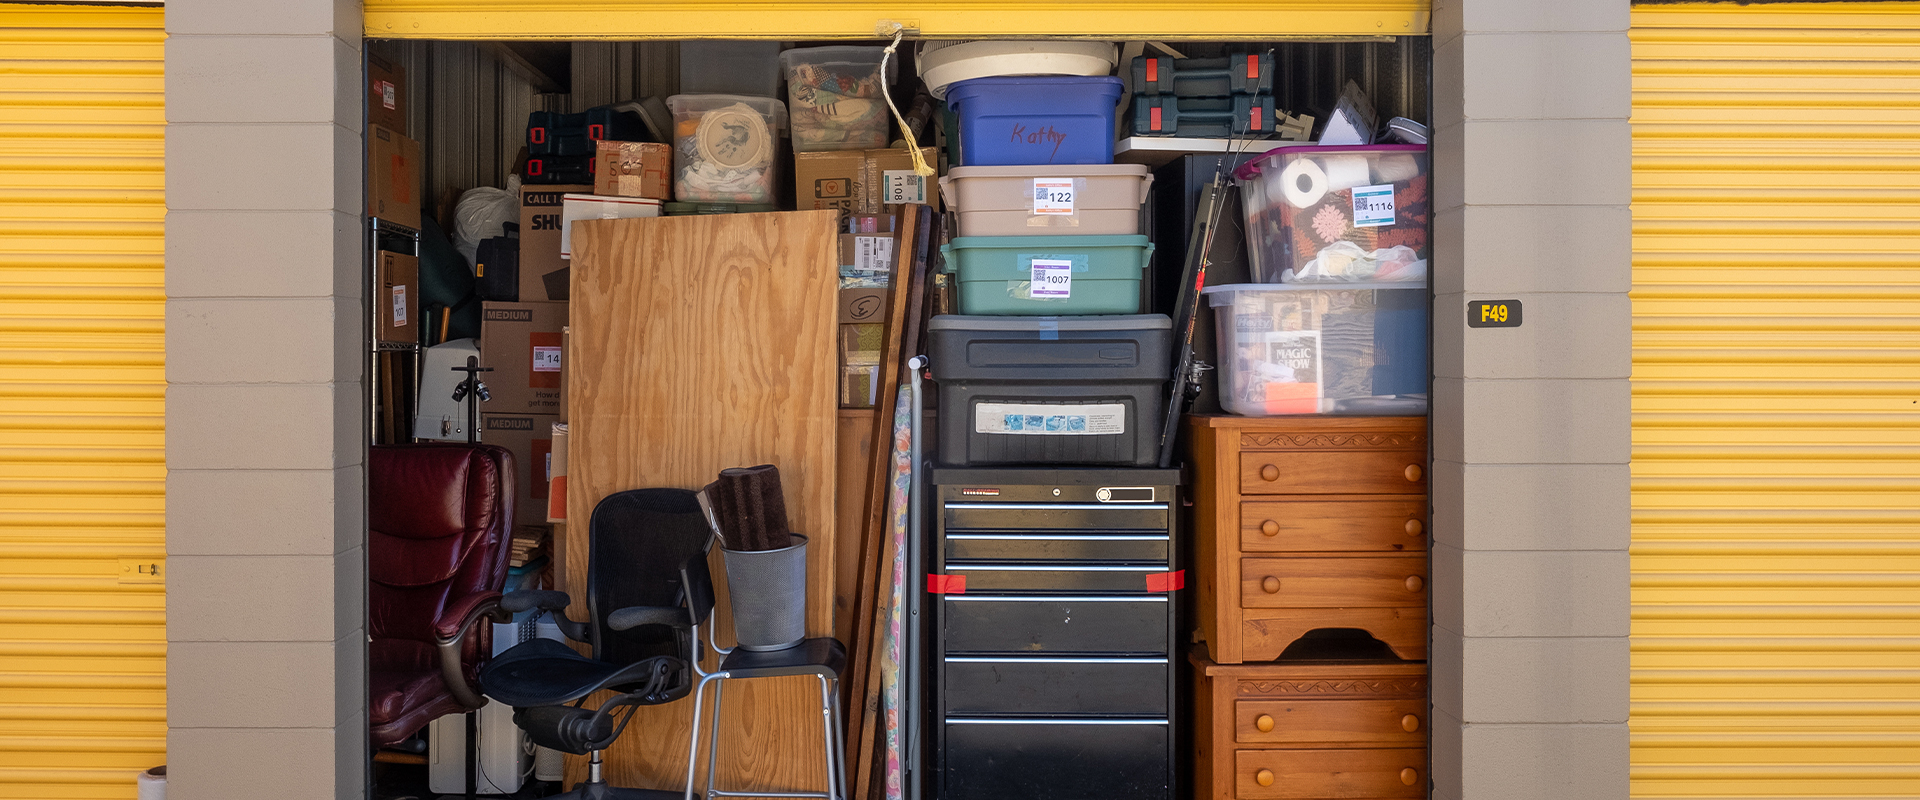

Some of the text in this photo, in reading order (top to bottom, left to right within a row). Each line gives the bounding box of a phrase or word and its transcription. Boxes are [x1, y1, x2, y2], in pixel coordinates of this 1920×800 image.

[1010, 122, 1067, 163] Kathy
[894, 175, 903, 201] 1108
[527, 194, 551, 204] CALL
[1049, 192, 1072, 203] 122
[1369, 201, 1393, 211] 1116
[1046, 275, 1069, 284] 1007
[487, 310, 529, 320] MEDIUM
[1481, 304, 1508, 322] F49
[547, 354, 560, 363] 14
[1276, 348, 1312, 359] MAGIC
[490, 419, 531, 429] MEDIUM
